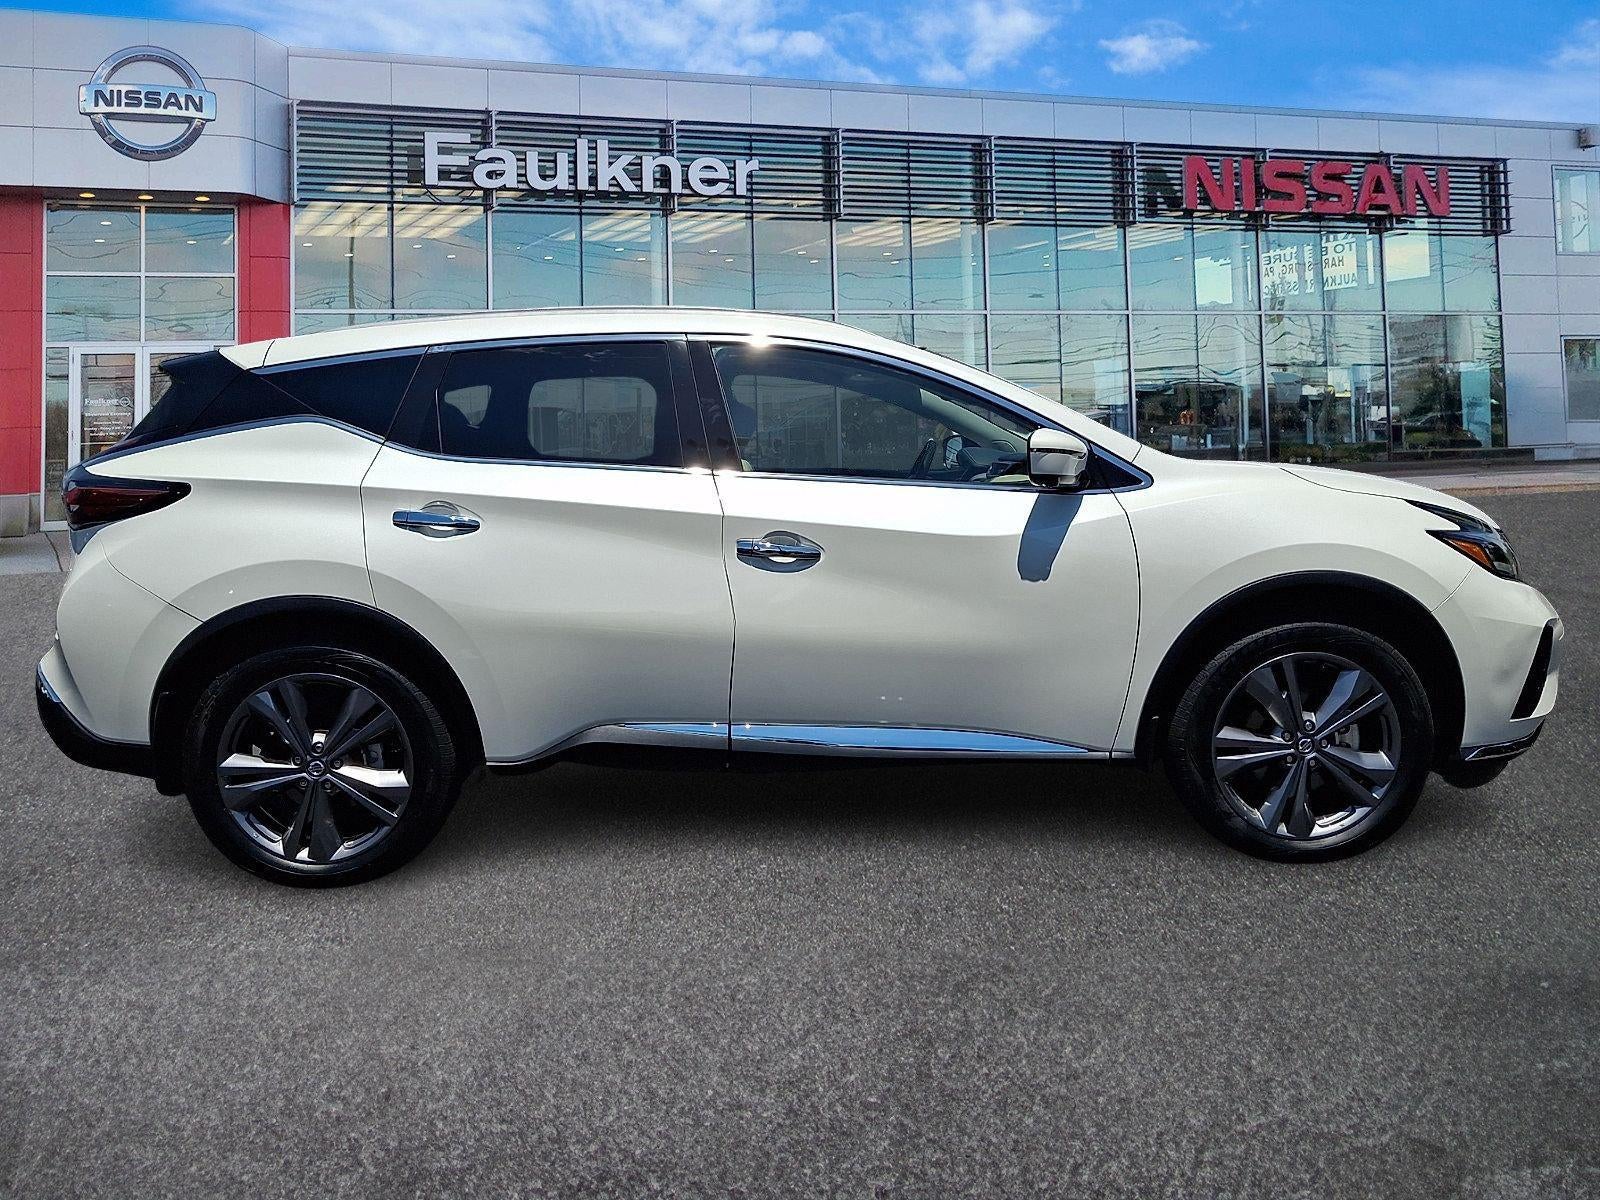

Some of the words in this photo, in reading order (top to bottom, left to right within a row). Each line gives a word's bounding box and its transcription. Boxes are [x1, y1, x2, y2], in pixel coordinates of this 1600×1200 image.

[93, 89, 204, 113] NISSAN
[423, 131, 760, 197] Faulkner
[1182, 155, 1451, 216] NISSAN
